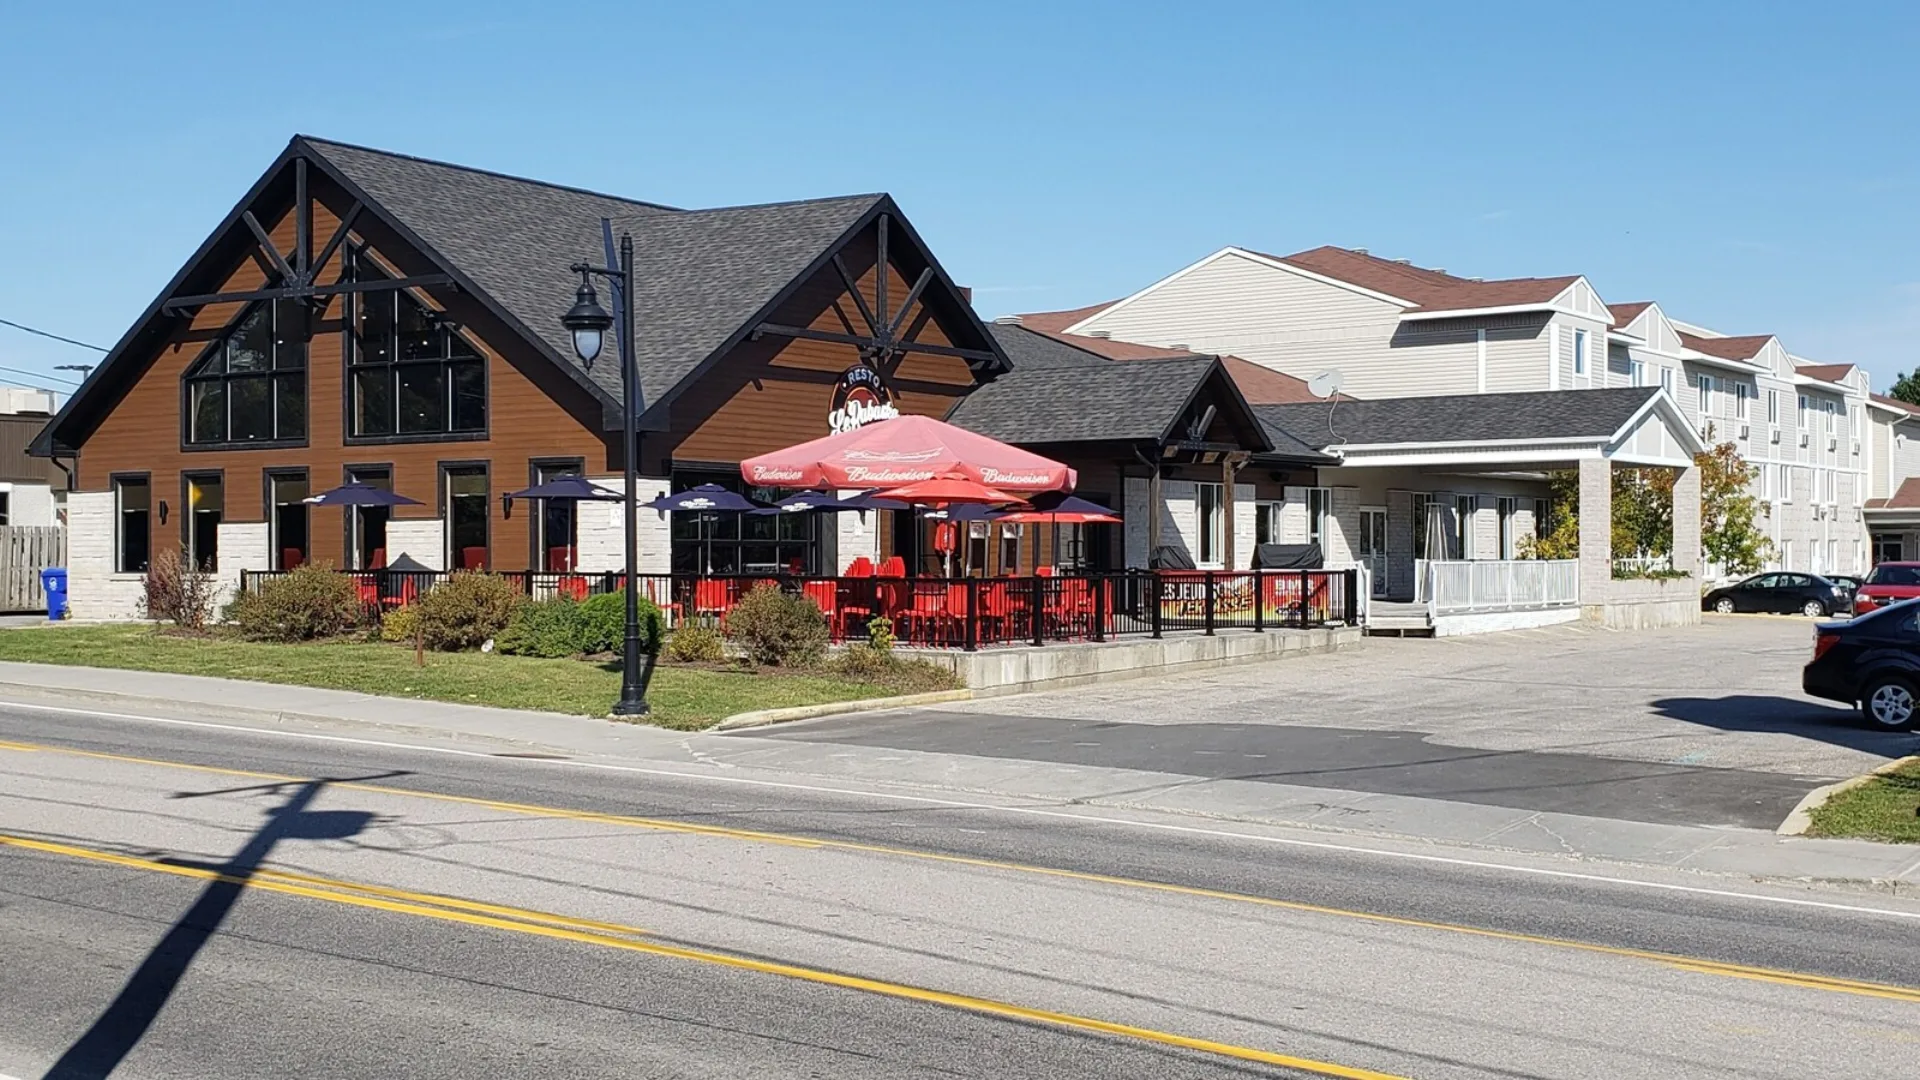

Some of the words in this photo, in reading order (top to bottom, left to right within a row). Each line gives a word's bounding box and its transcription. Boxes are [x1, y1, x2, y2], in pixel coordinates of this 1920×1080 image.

[848, 368, 880, 388] RESTO
[753, 466, 803, 481] Budweiser
[844, 466, 934, 482] Budweiser
[980, 467, 1050, 484] Budweiser
[1160, 582, 1176, 600] ES
